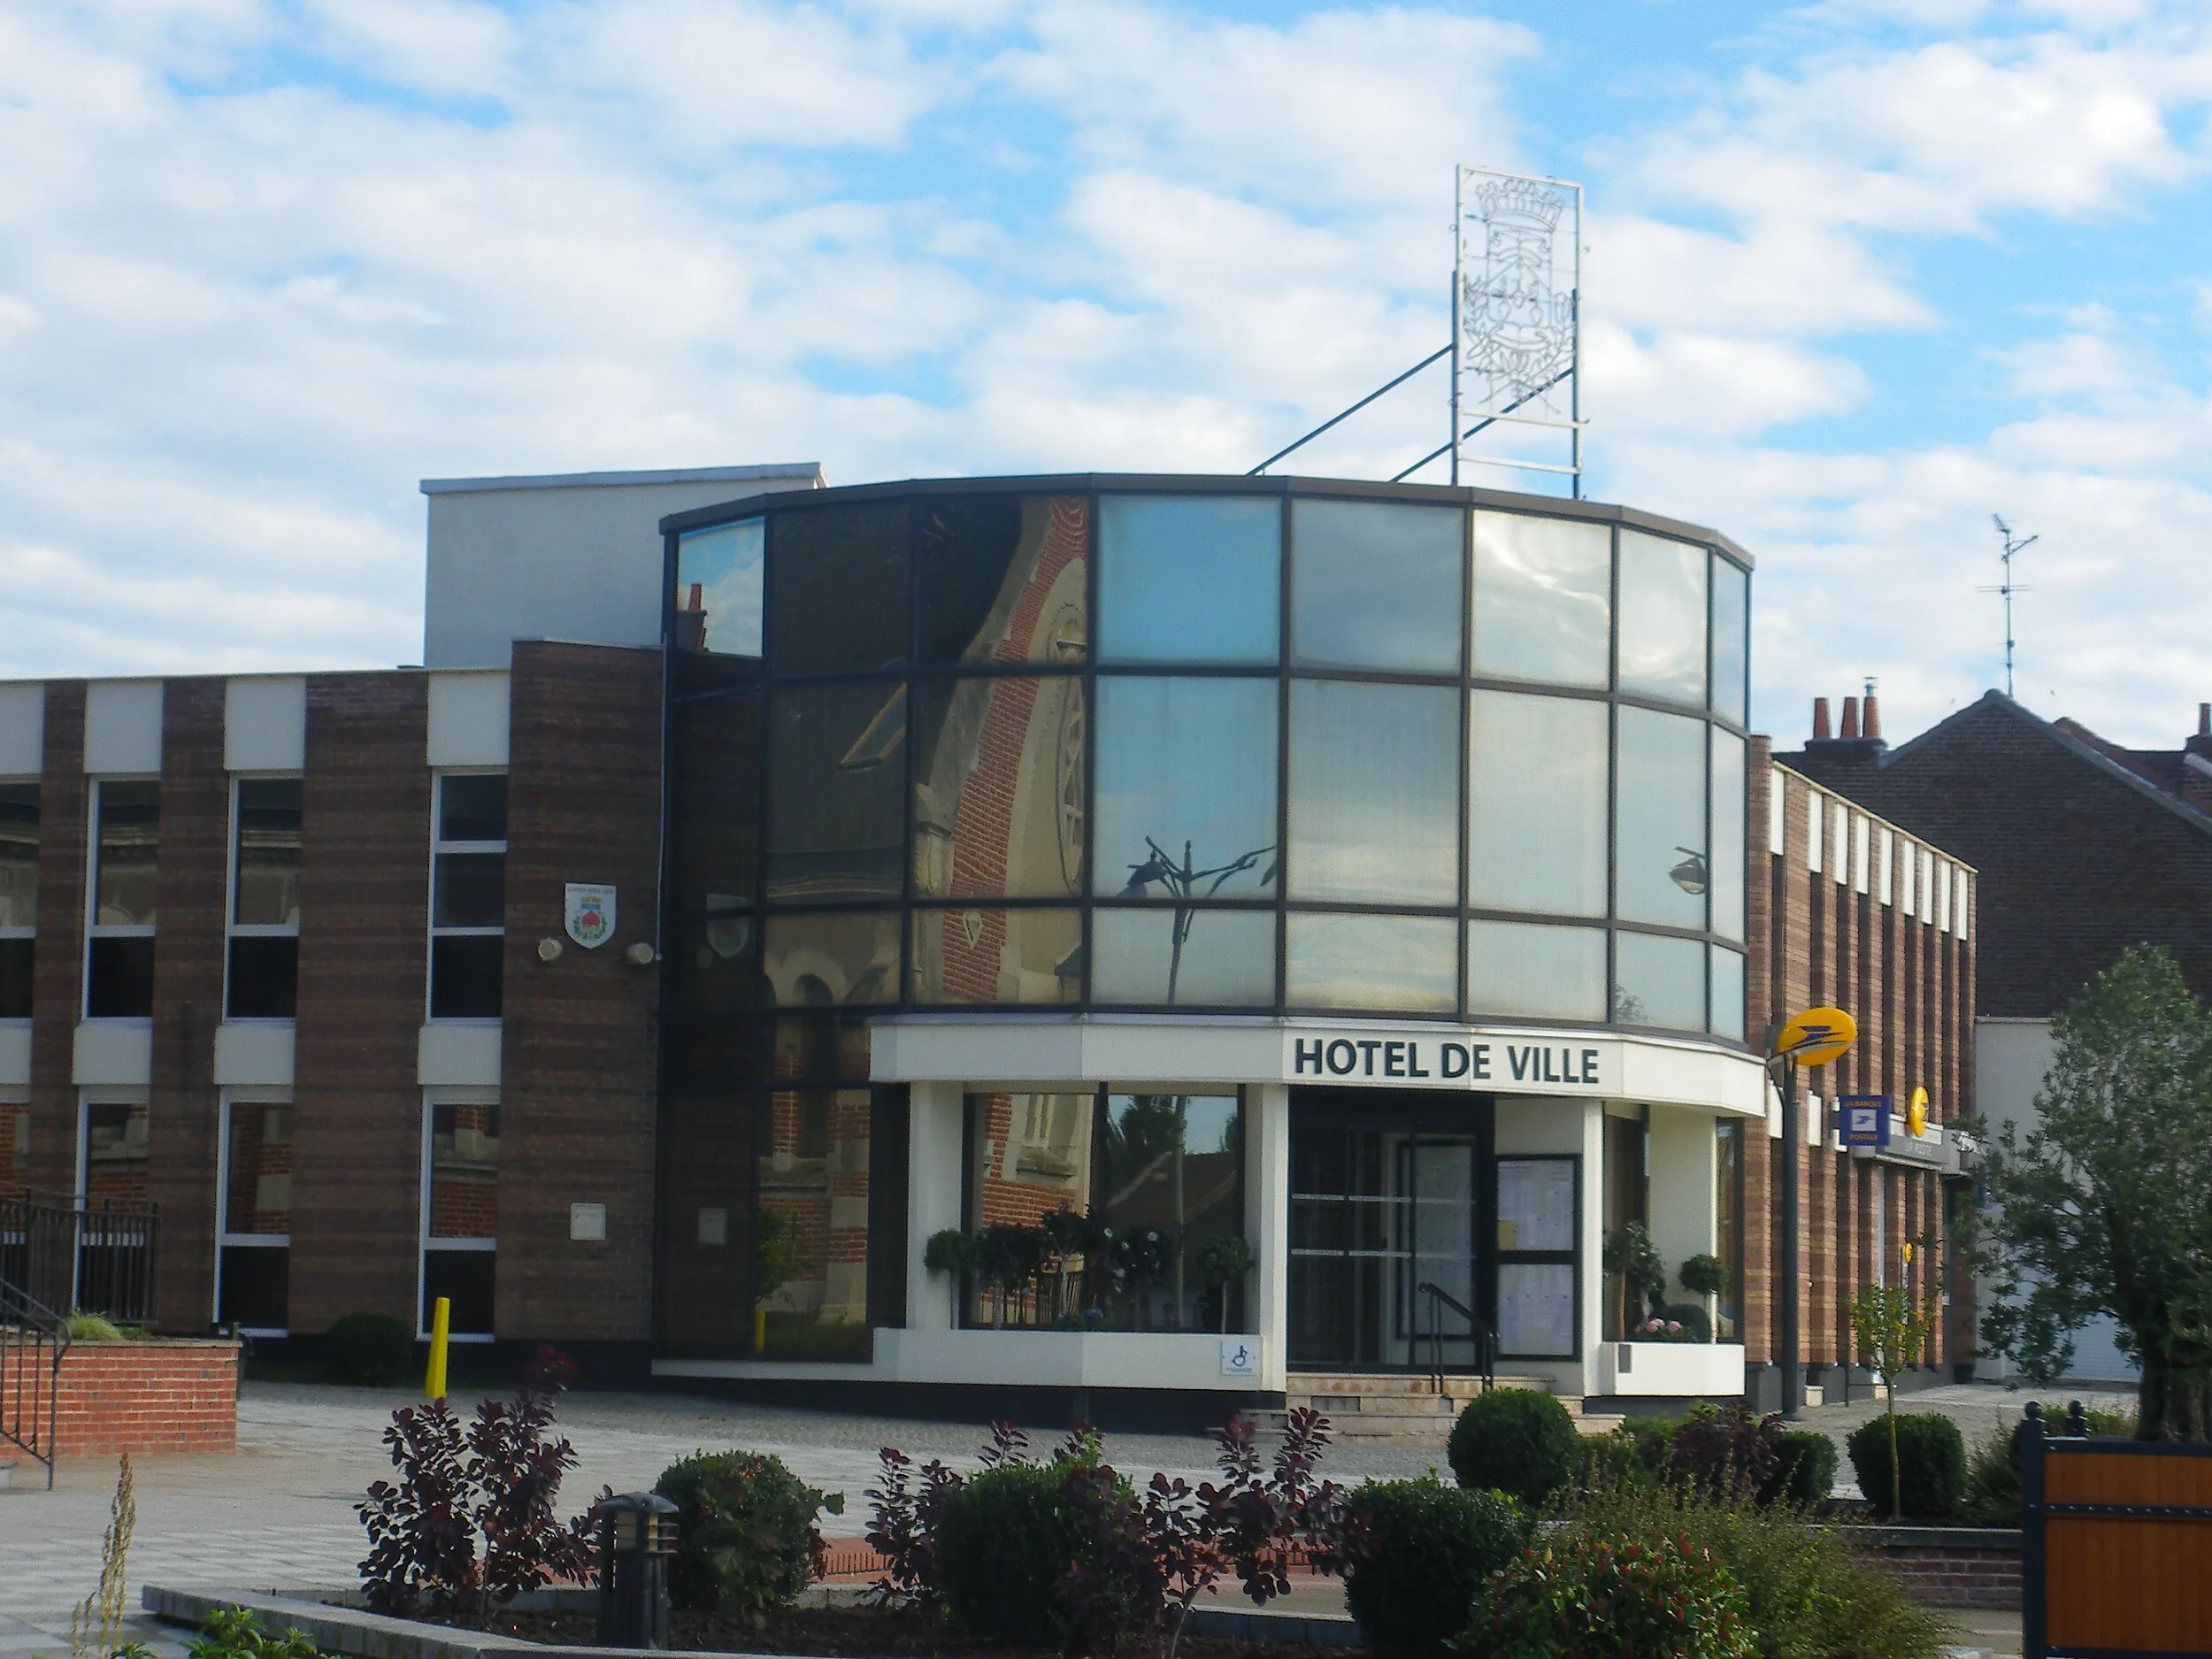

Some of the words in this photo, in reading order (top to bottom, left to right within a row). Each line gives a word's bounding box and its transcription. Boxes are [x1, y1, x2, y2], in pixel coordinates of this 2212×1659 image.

[1294, 1038, 1429, 1078] HOTEL
[1441, 1042, 1491, 1079] DE
[1507, 1045, 1600, 1084] VILLE
